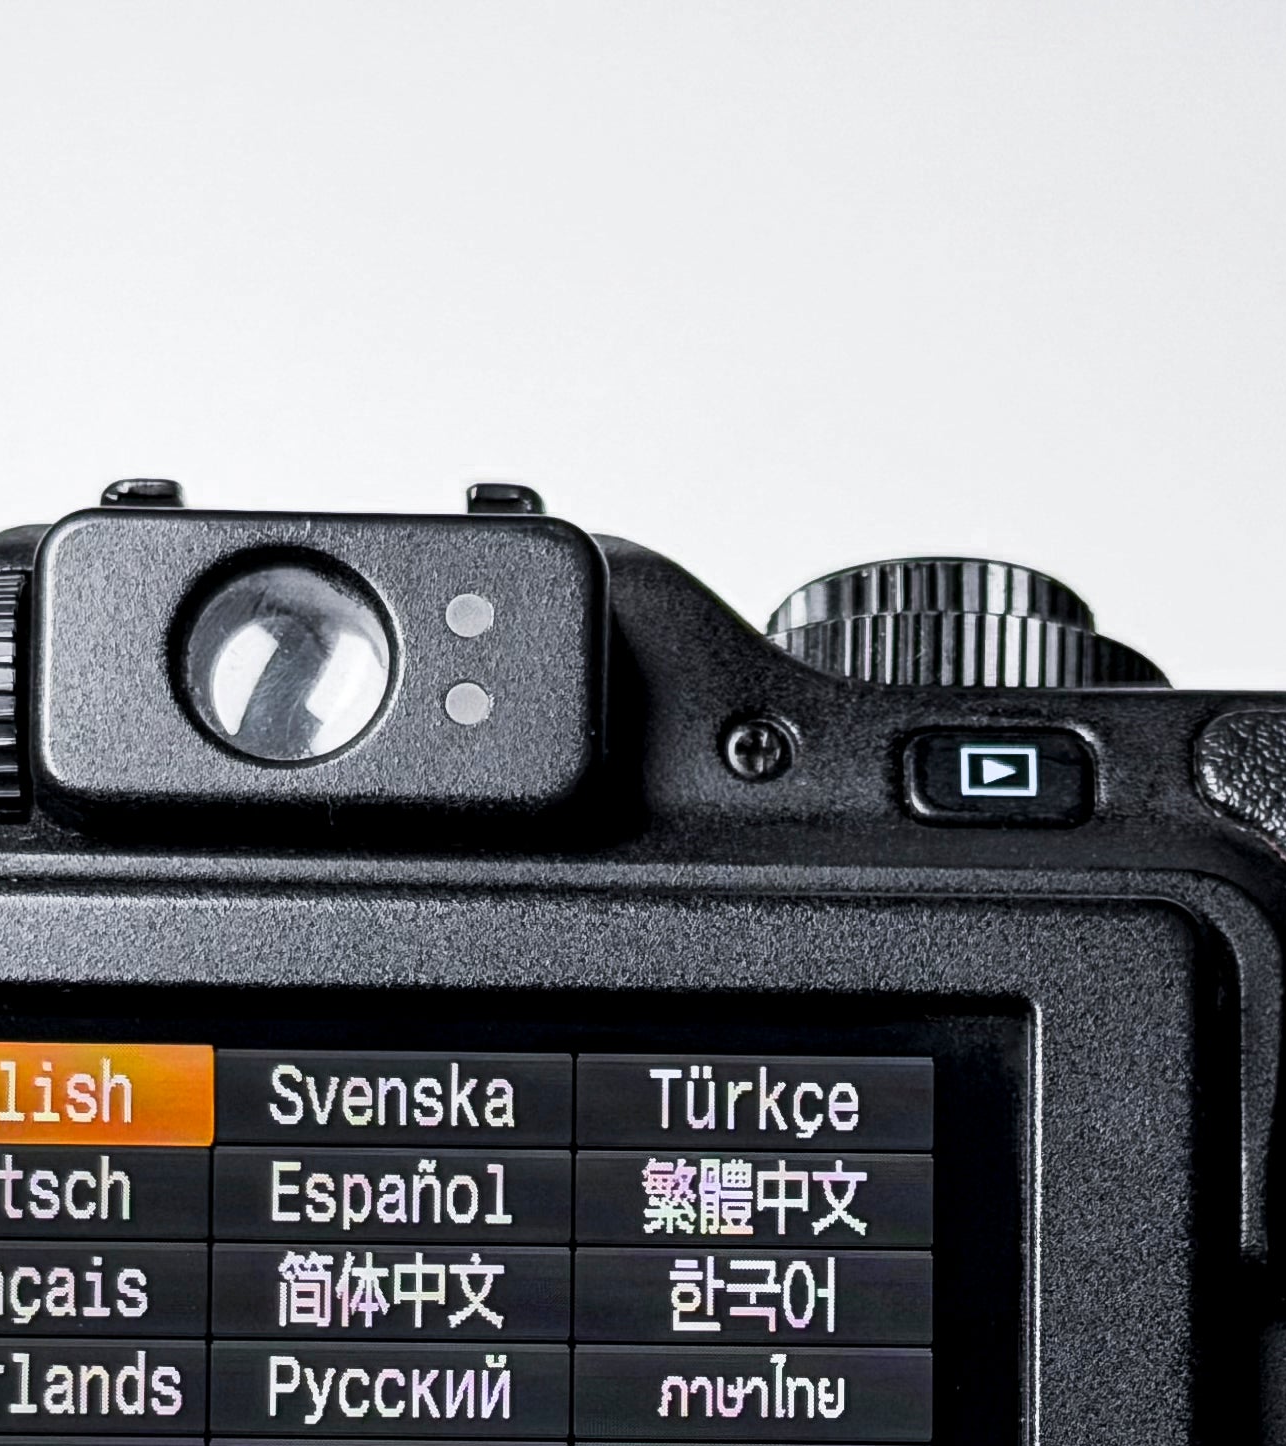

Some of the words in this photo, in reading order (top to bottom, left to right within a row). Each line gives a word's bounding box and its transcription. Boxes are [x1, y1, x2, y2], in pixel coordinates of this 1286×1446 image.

[268, 1062, 515, 1128] Svenska
[648, 1064, 859, 1139] Türkçe
[271, 1158, 513, 1231] Español
[641, 1157, 868, 1236] 繁體中文
[277, 1250, 505, 1330] 简体中文
[668, 1255, 836, 1333] 한국어
[268, 1354, 511, 1425] Русский
[656, 1353, 845, 1419] ภาษาไทย
